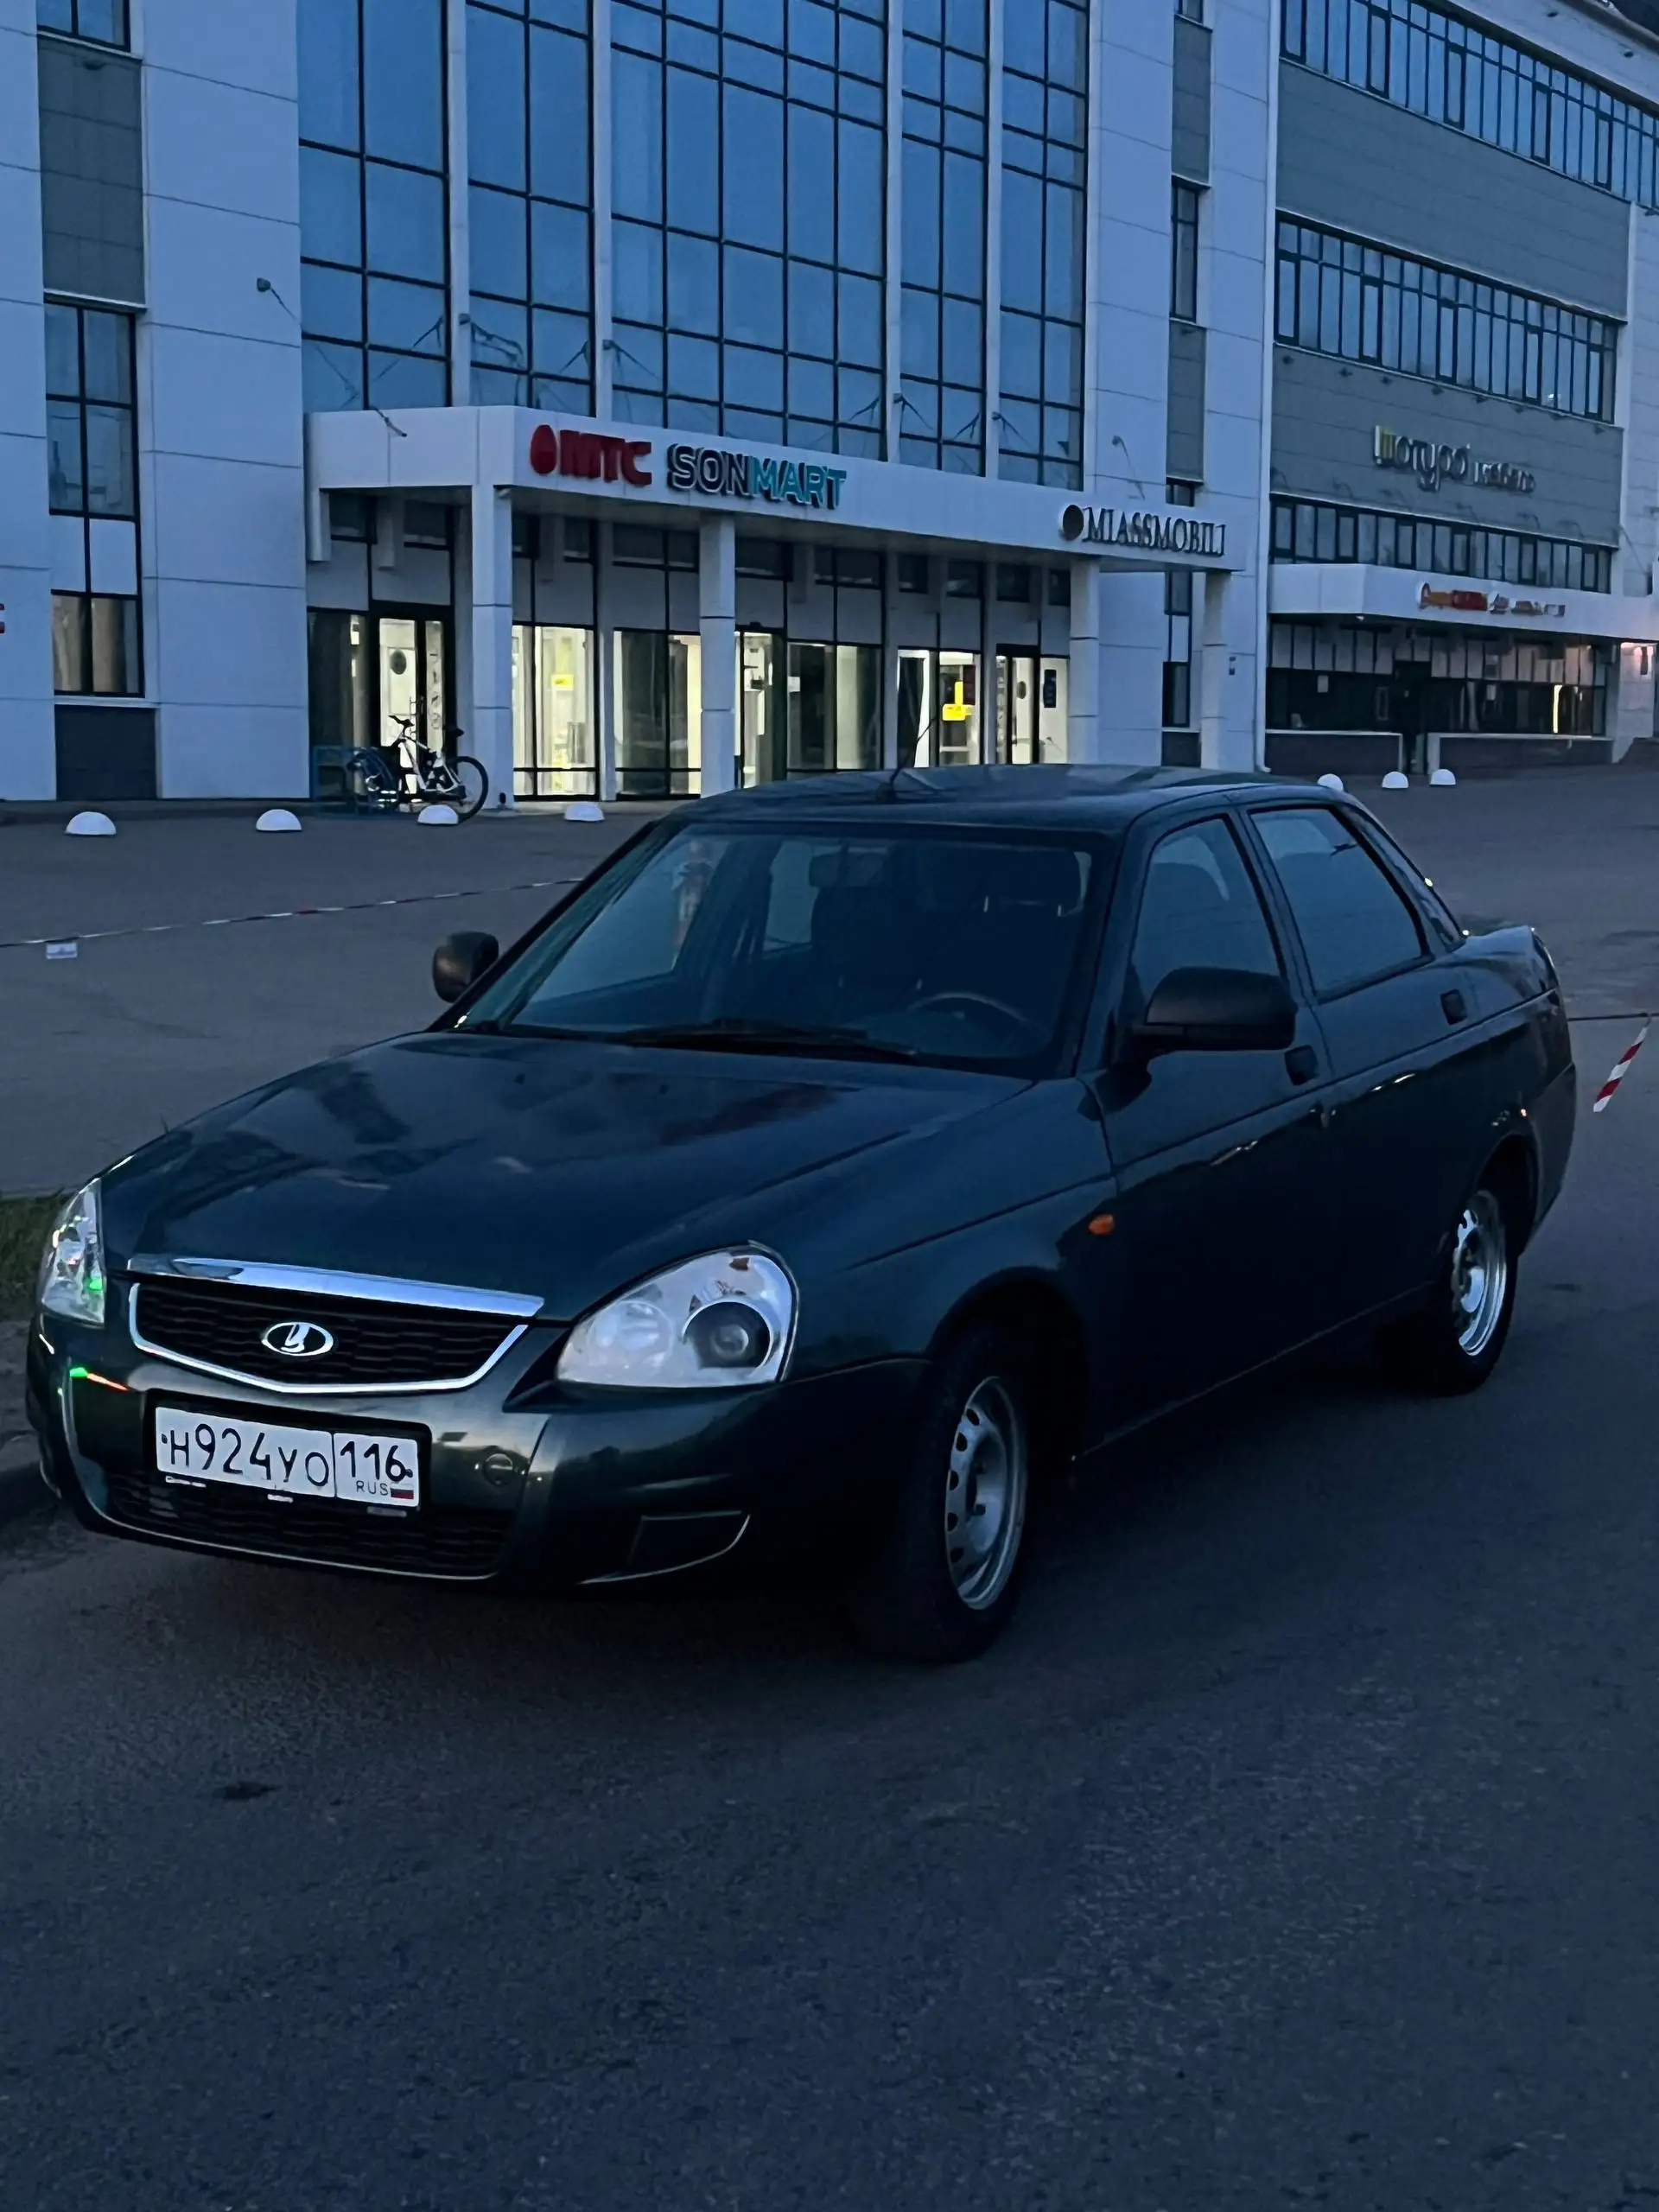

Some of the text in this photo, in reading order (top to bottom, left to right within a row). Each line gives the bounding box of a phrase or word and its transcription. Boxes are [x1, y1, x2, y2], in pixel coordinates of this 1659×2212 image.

[667, 443, 847, 510] SONMART
[340, 1440, 407, 1483] 116
[355, 1479, 389, 1497] RUS
